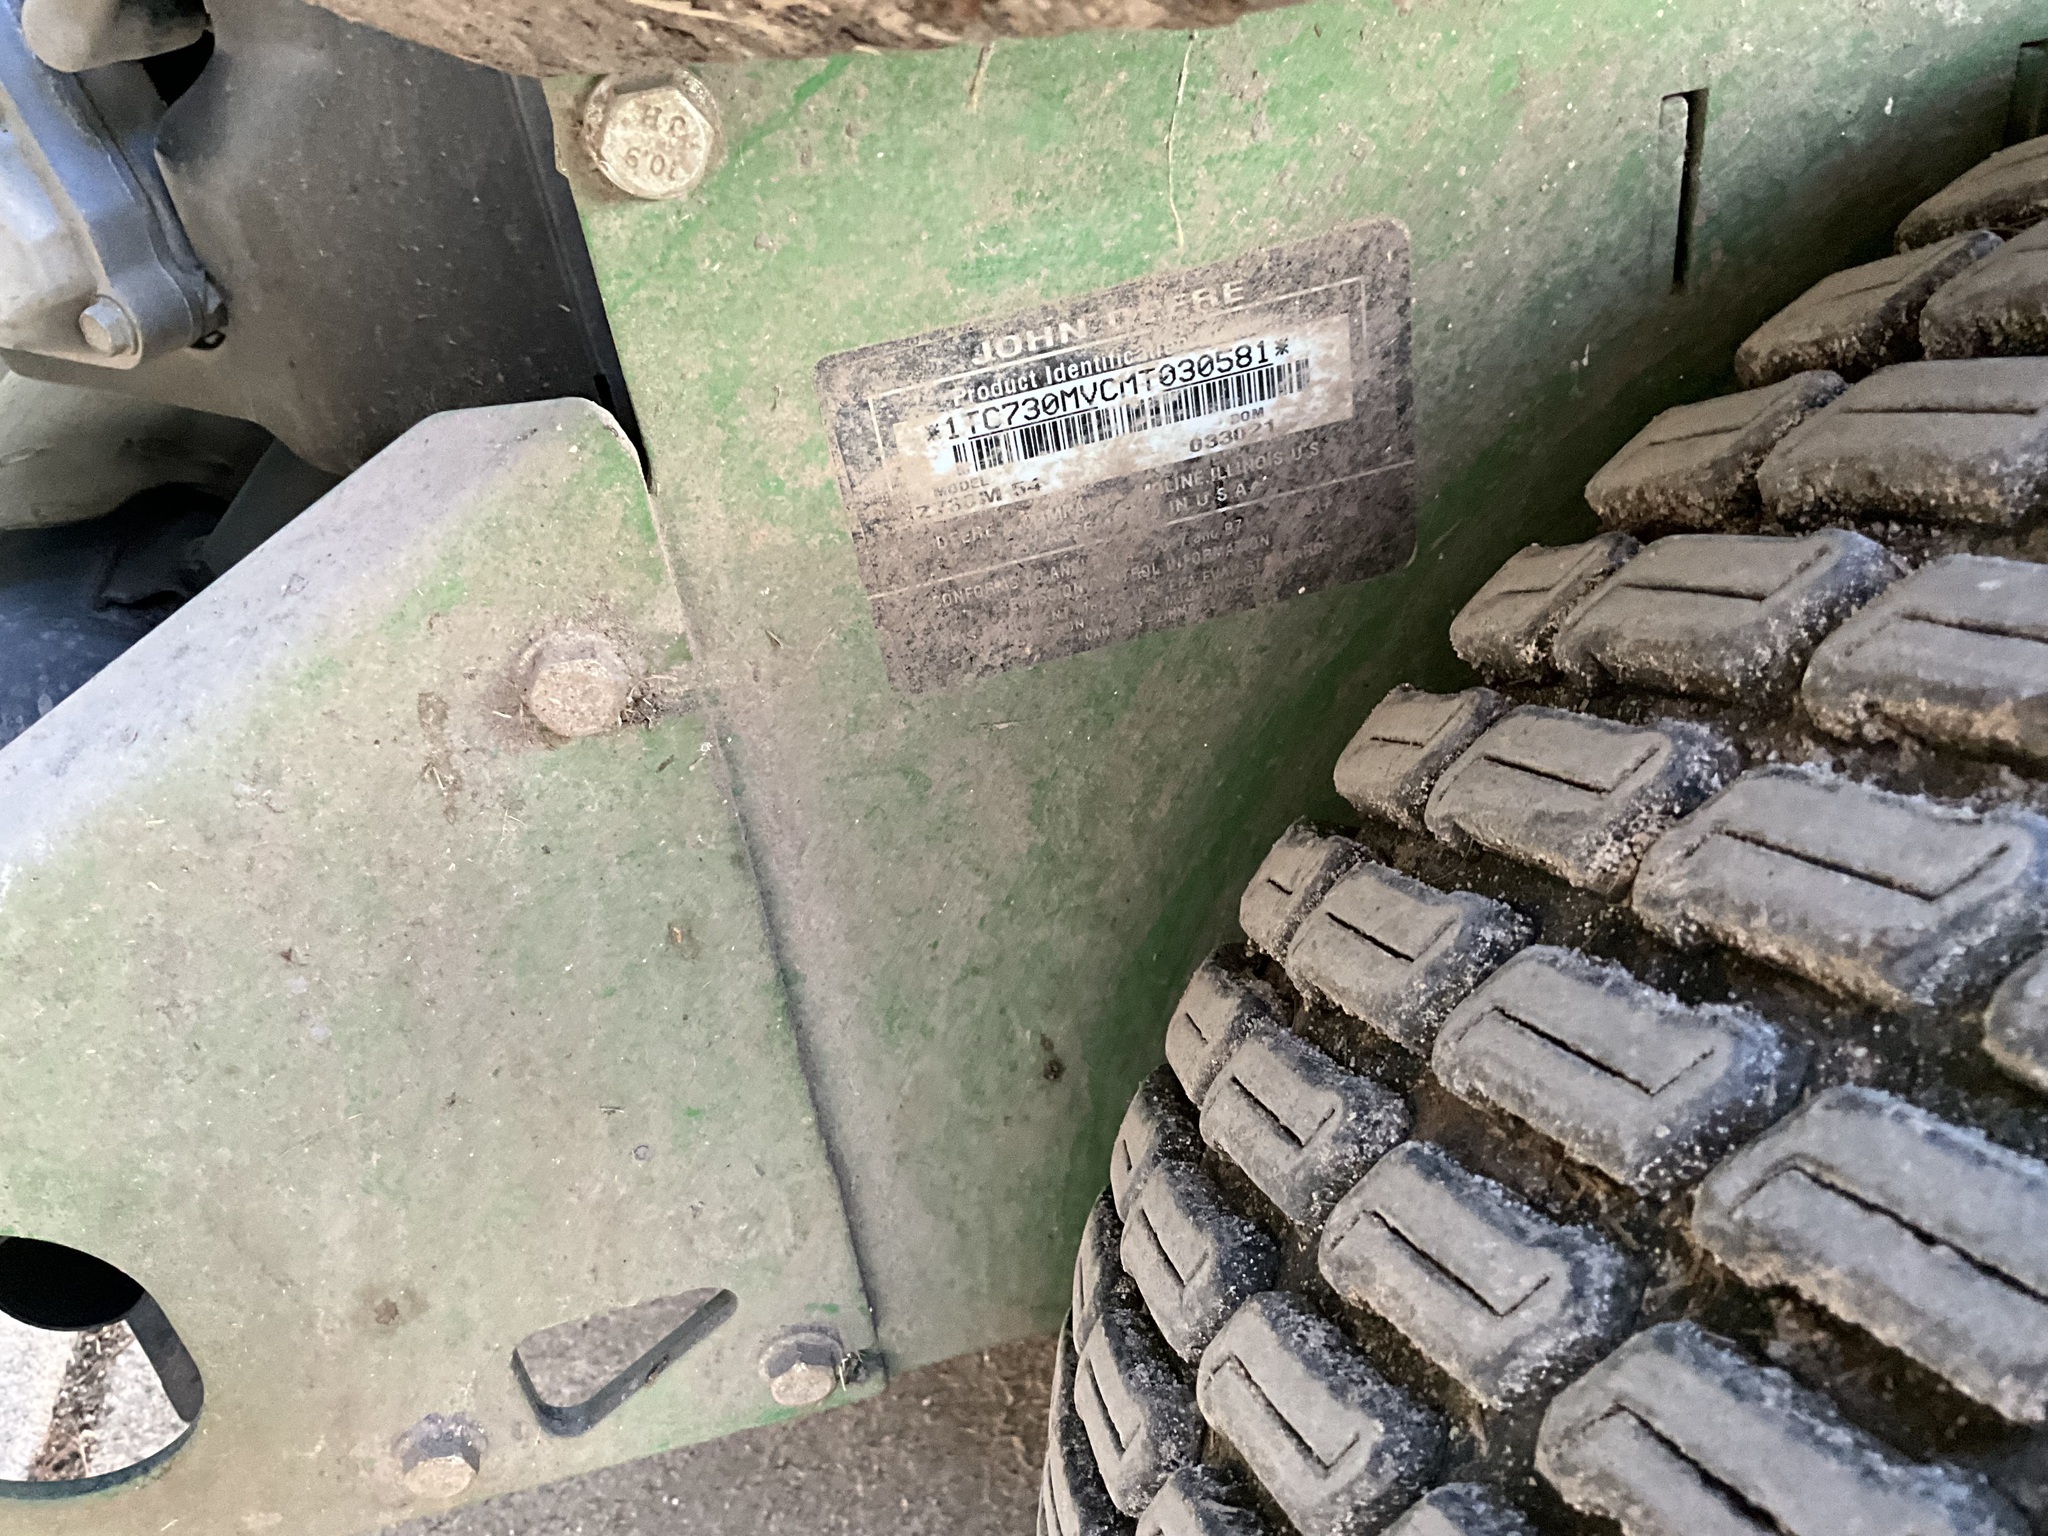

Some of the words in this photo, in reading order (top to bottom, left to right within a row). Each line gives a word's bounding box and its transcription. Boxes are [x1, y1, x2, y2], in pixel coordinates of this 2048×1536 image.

[968, 316, 1089, 366] JOHN
[1107, 278, 1247, 332] DERE
[951, 370, 1038, 407] Product
[1229, 406, 1266, 425] DOM
[933, 475, 990, 498] MODEL
[935, 522, 997, 550] DERE
